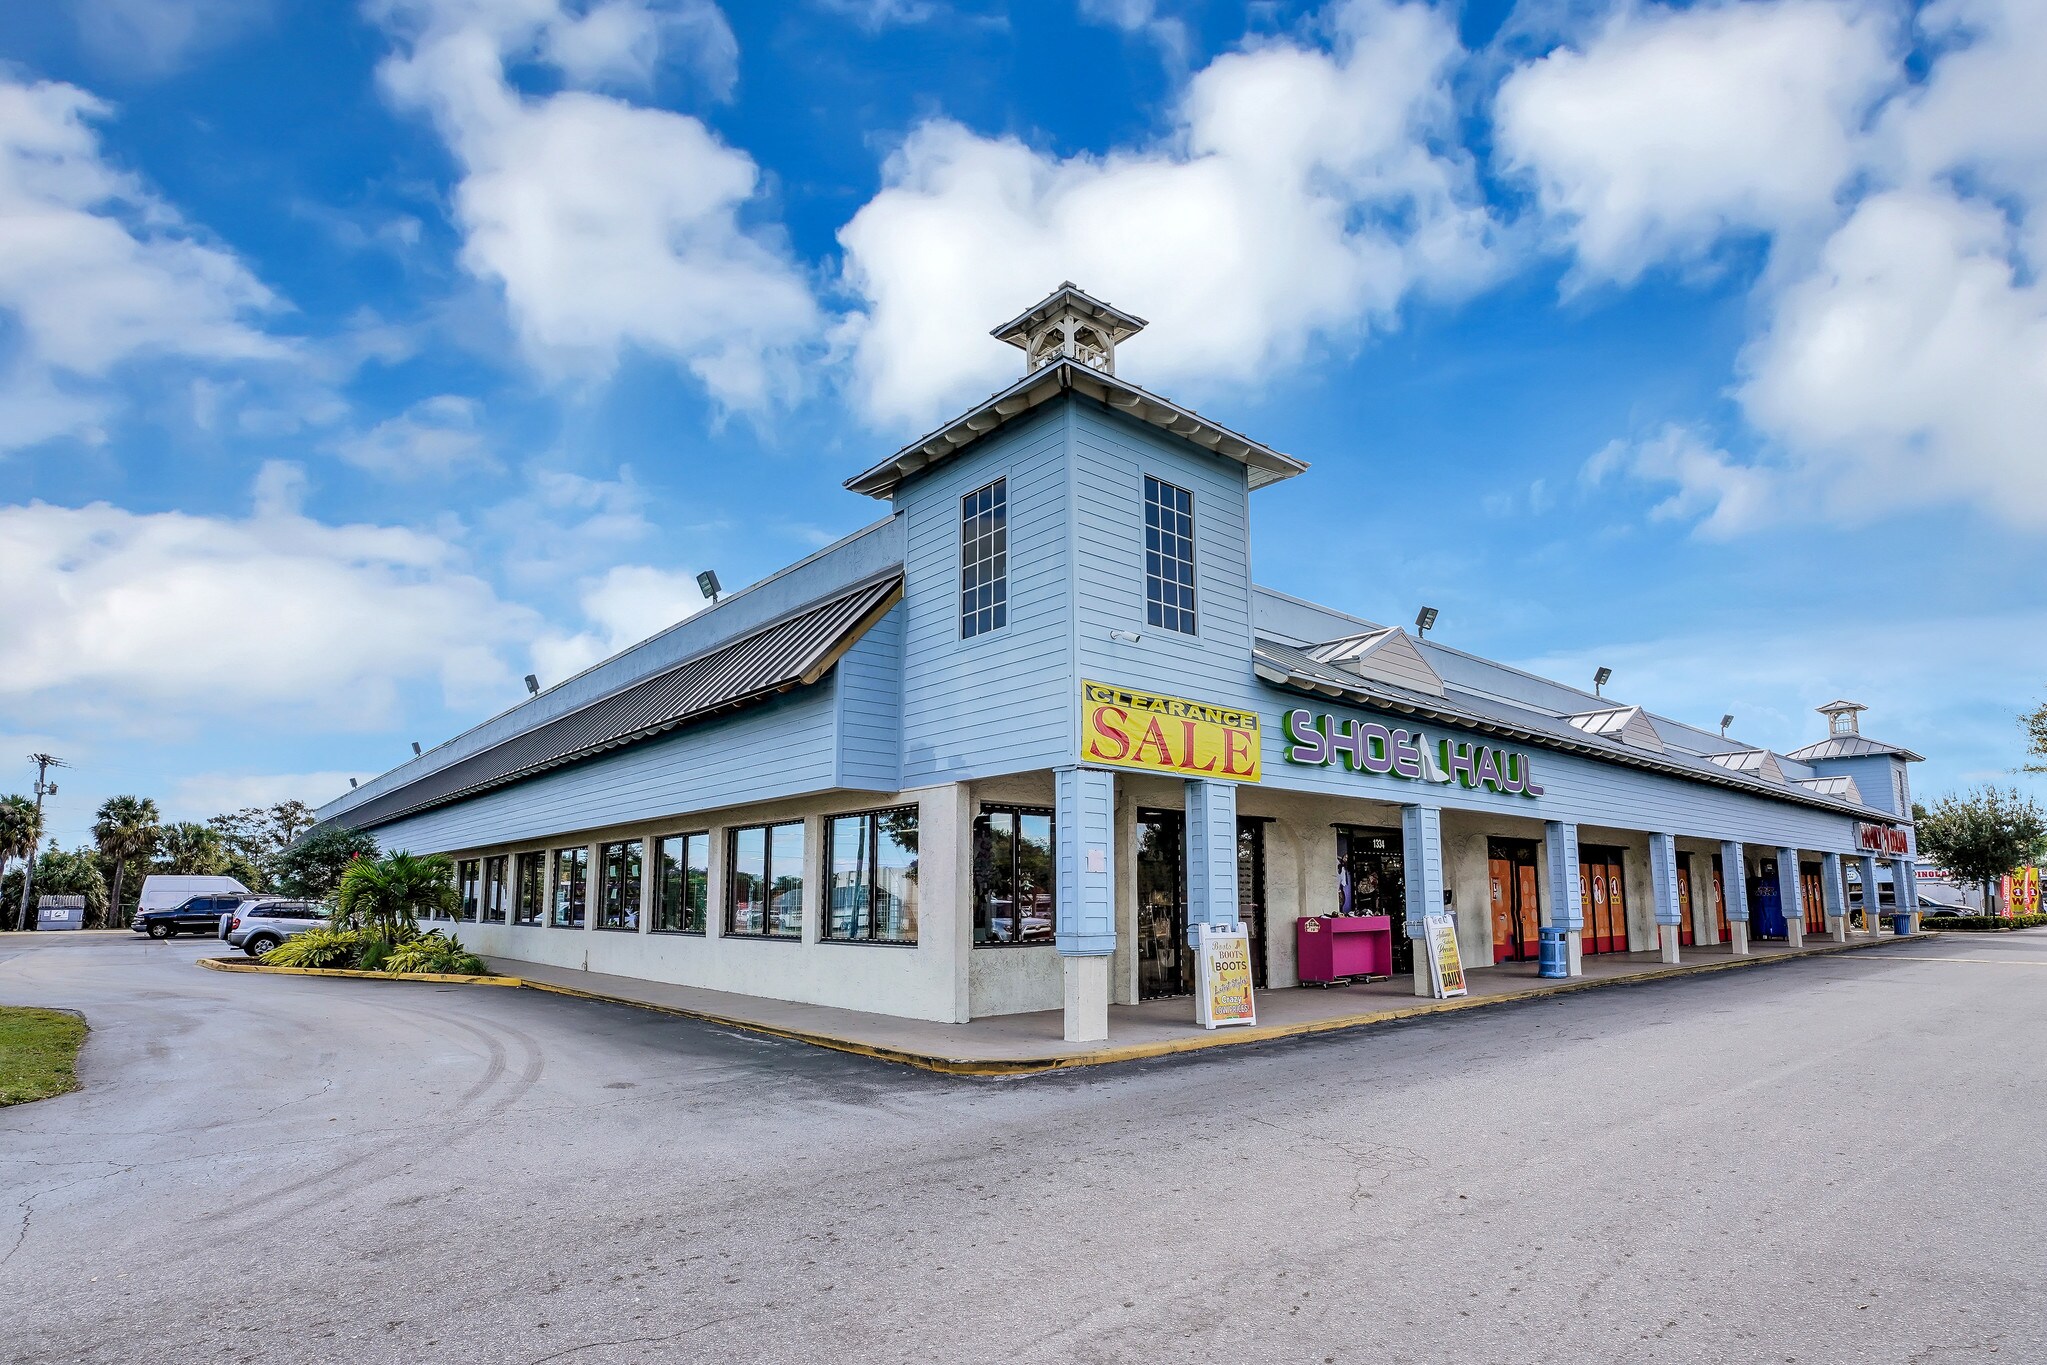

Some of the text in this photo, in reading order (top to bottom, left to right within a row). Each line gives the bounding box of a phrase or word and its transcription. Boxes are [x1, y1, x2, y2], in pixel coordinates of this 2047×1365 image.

[1090, 686, 1254, 729] CLEARANCE
[1089, 706, 1256, 777] SALE
[1283, 709, 1545, 797] SHOE HAUL
[1373, 838, 1385, 849] 1334
[1219, 950, 1244, 960] BOOTS
[1215, 961, 1247, 972] BOOTS
[1442, 970, 1463, 987] DAILY
[1221, 995, 1242, 1007] Crazy
